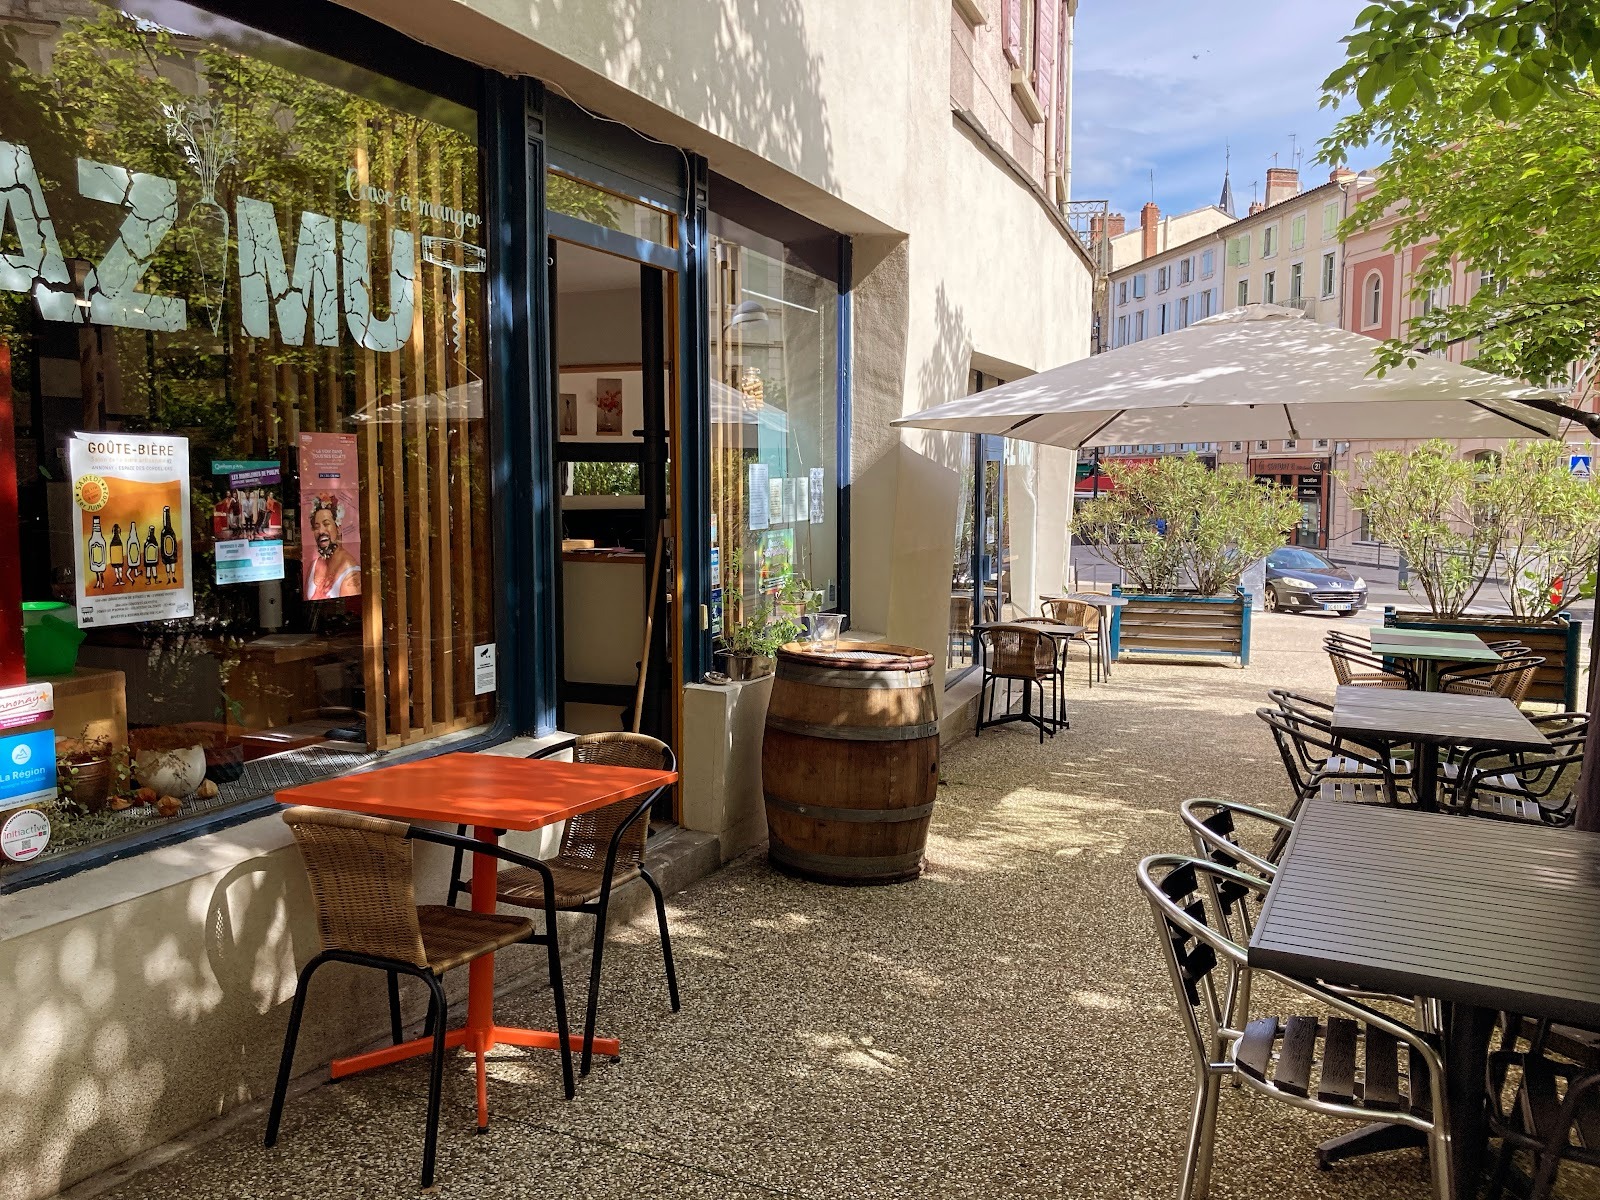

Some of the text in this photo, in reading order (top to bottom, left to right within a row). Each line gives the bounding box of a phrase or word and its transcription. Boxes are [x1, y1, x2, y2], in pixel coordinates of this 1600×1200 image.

[419, 199, 483, 239] manger
[88, 440, 174, 456] GOÛTE-BIÈRE
[75, 475, 101, 491] SAMEDI
[87, 503, 102, 511] JUIN
[101, 486, 109, 504] 2024
[0, 767, 46, 783] La Région
[3, 823, 48, 840] initiactive
